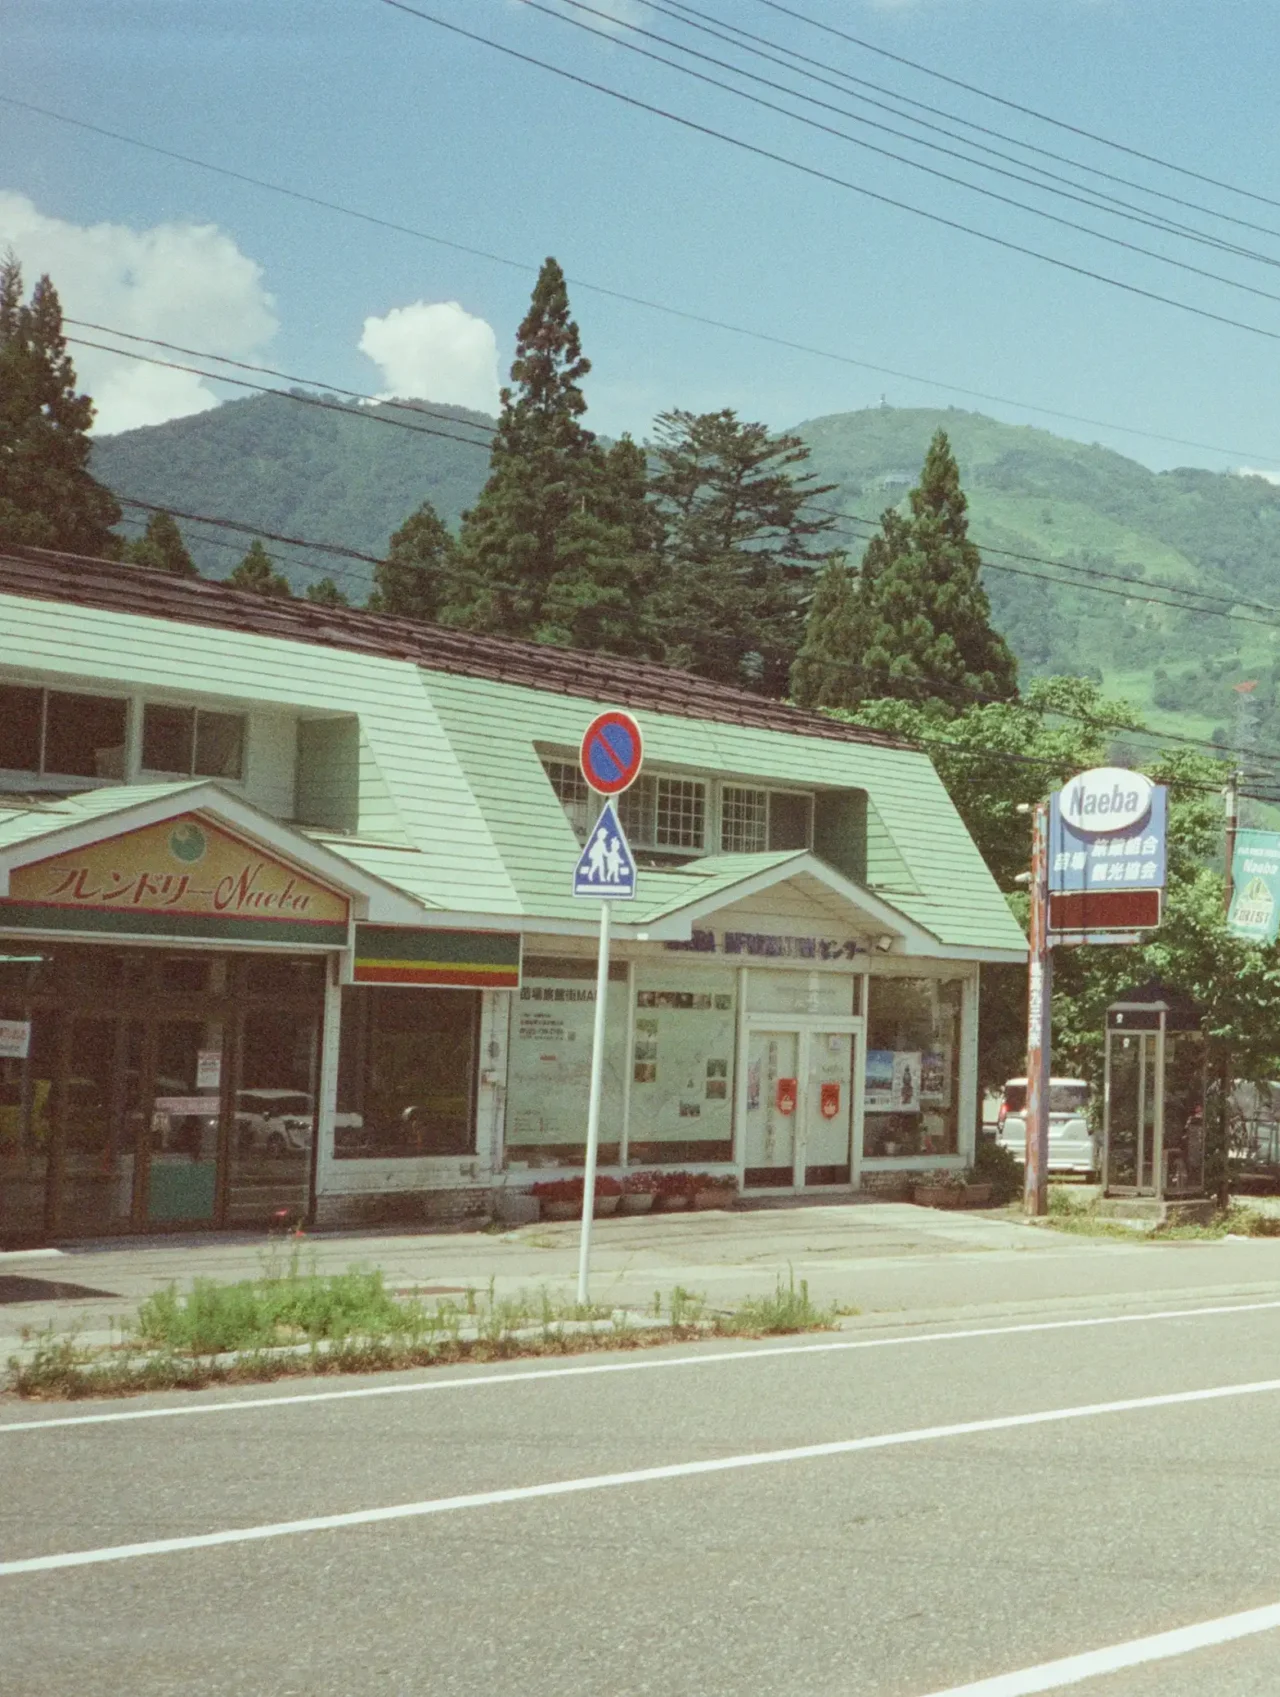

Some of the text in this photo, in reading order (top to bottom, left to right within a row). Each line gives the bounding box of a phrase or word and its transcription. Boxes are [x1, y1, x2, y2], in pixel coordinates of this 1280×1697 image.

[1070, 783, 1139, 816] Naeba
[1243, 859, 1279, 875] Naeba
[48, 863, 312, 911] フレンドリー Naeba
